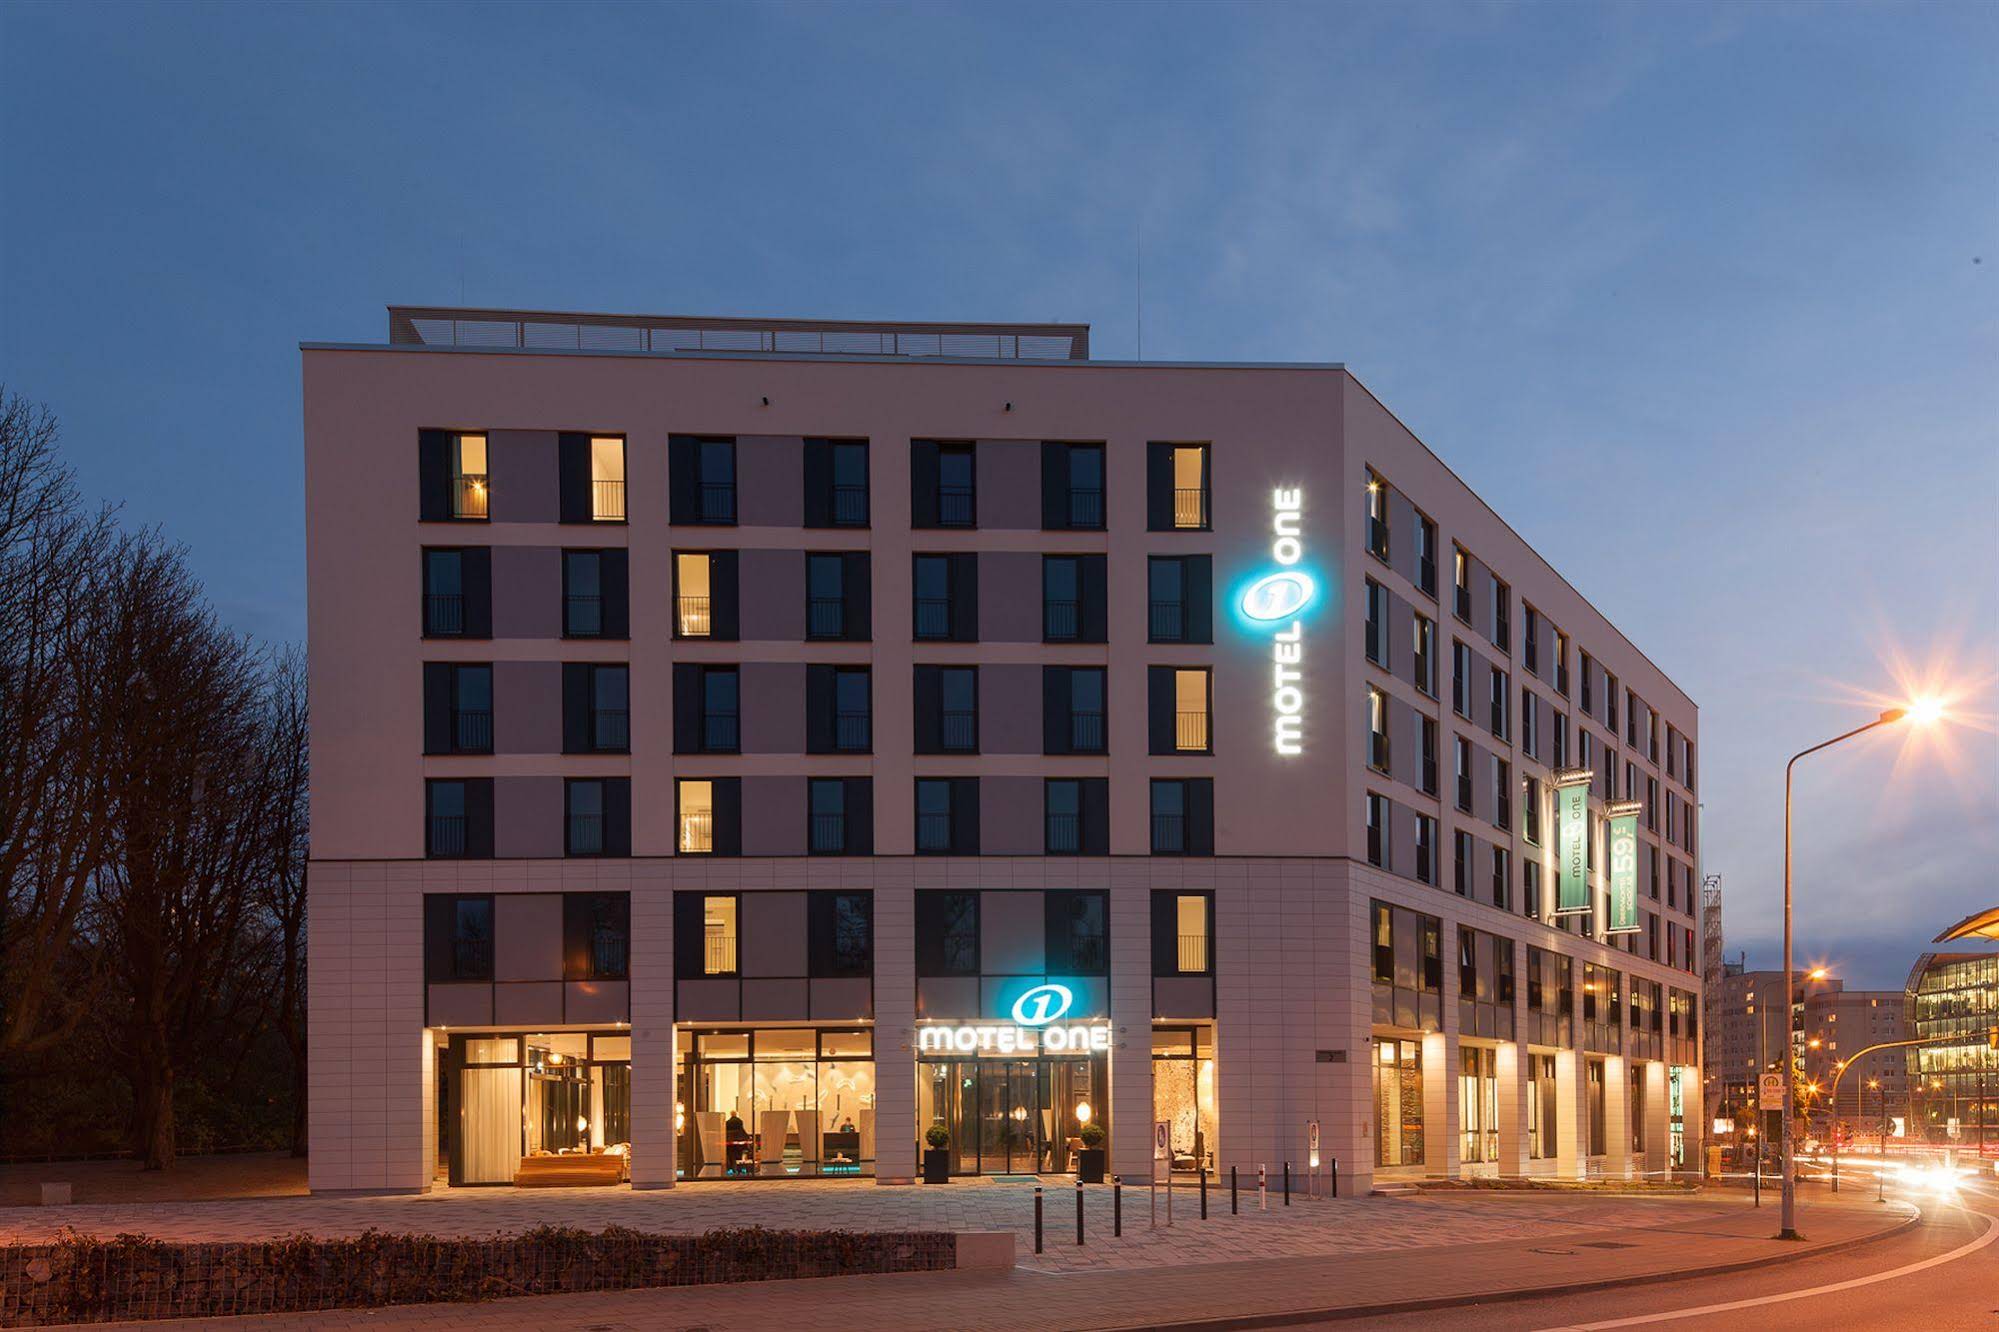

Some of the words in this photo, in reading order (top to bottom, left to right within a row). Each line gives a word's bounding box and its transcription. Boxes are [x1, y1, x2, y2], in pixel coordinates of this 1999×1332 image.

[1274, 488, 1302, 565] ONE
[1275, 621, 1303, 755] MOTEL
[1572, 795, 1581, 819] ONE
[1571, 837, 1581, 878] MOTEL
[919, 1026, 1034, 1052] MOTEL
[1042, 1026, 1111, 1051] ONE
